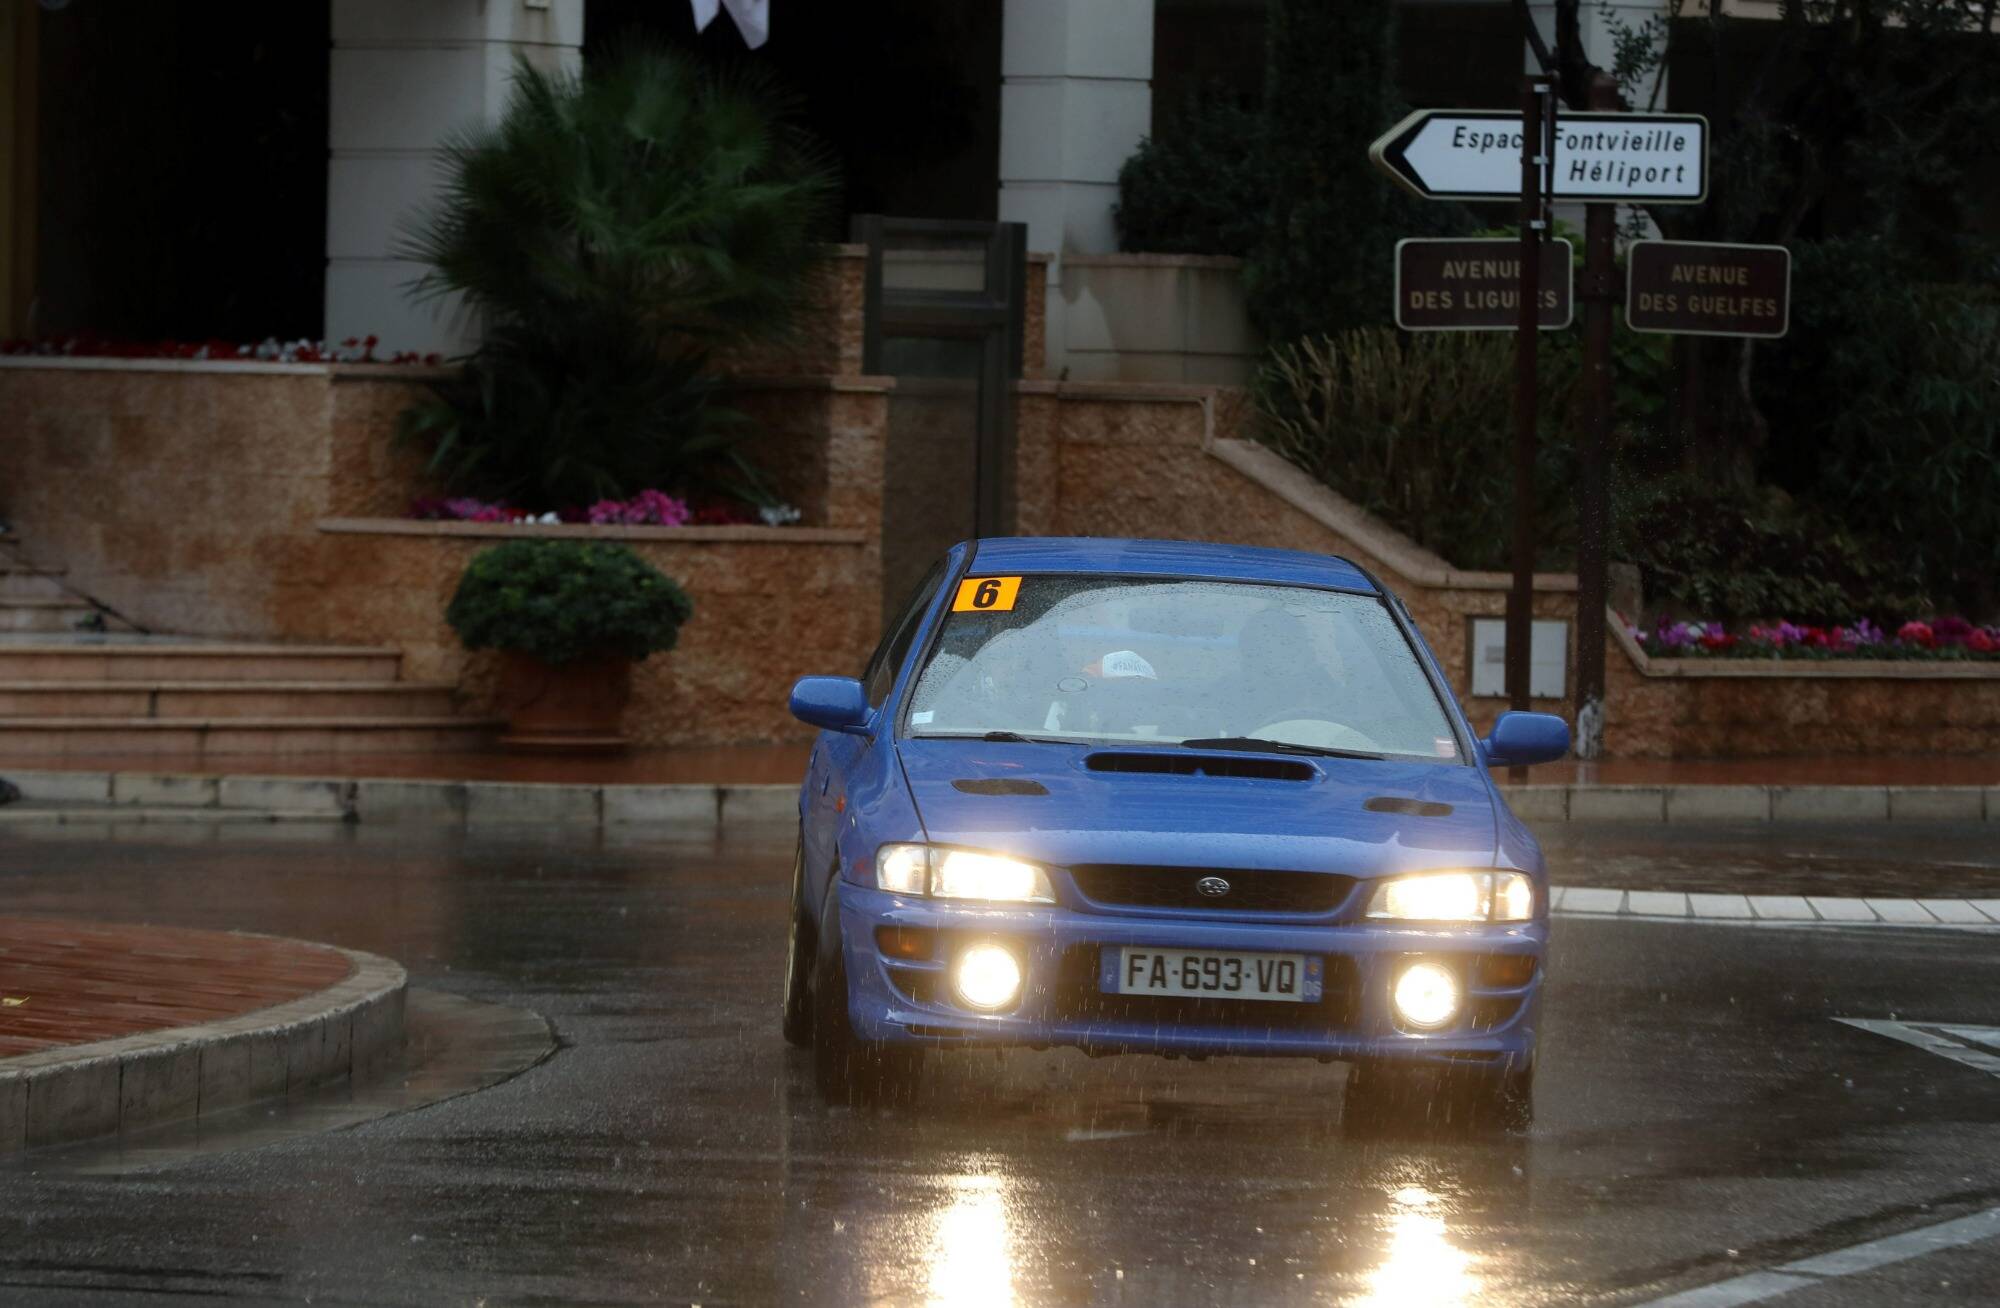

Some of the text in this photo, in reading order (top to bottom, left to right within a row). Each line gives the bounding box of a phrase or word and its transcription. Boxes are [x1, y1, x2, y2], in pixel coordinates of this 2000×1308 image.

[1452, 126, 1525, 153] Espac
[1568, 159, 1686, 188] Héliport
[1671, 264, 1749, 286] AVENUE
[1410, 289, 1559, 310] DES LIGUS
[1638, 292, 1778, 317] DES GUELFES
[972, 580, 1002, 608] 6
[1127, 953, 1297, 994] FA-693-VQ
